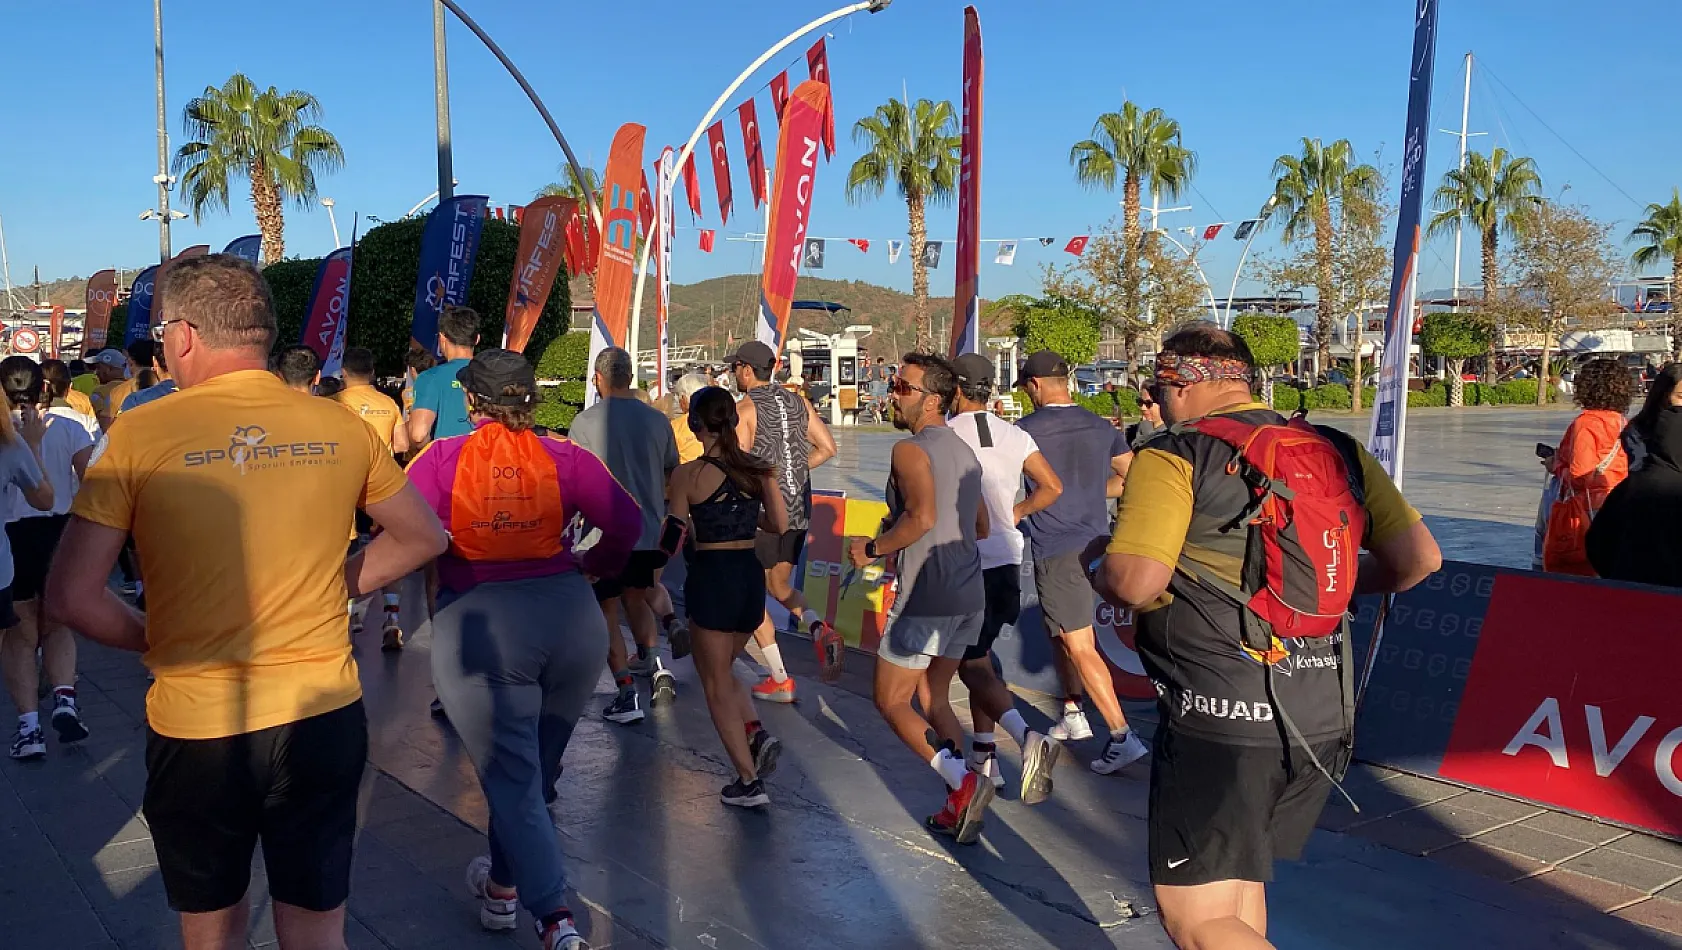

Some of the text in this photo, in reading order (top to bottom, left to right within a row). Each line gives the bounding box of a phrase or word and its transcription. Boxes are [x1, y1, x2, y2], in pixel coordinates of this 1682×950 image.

[319, 276, 347, 346] AVON
[775, 395, 797, 495] UNDER ARMOUR
